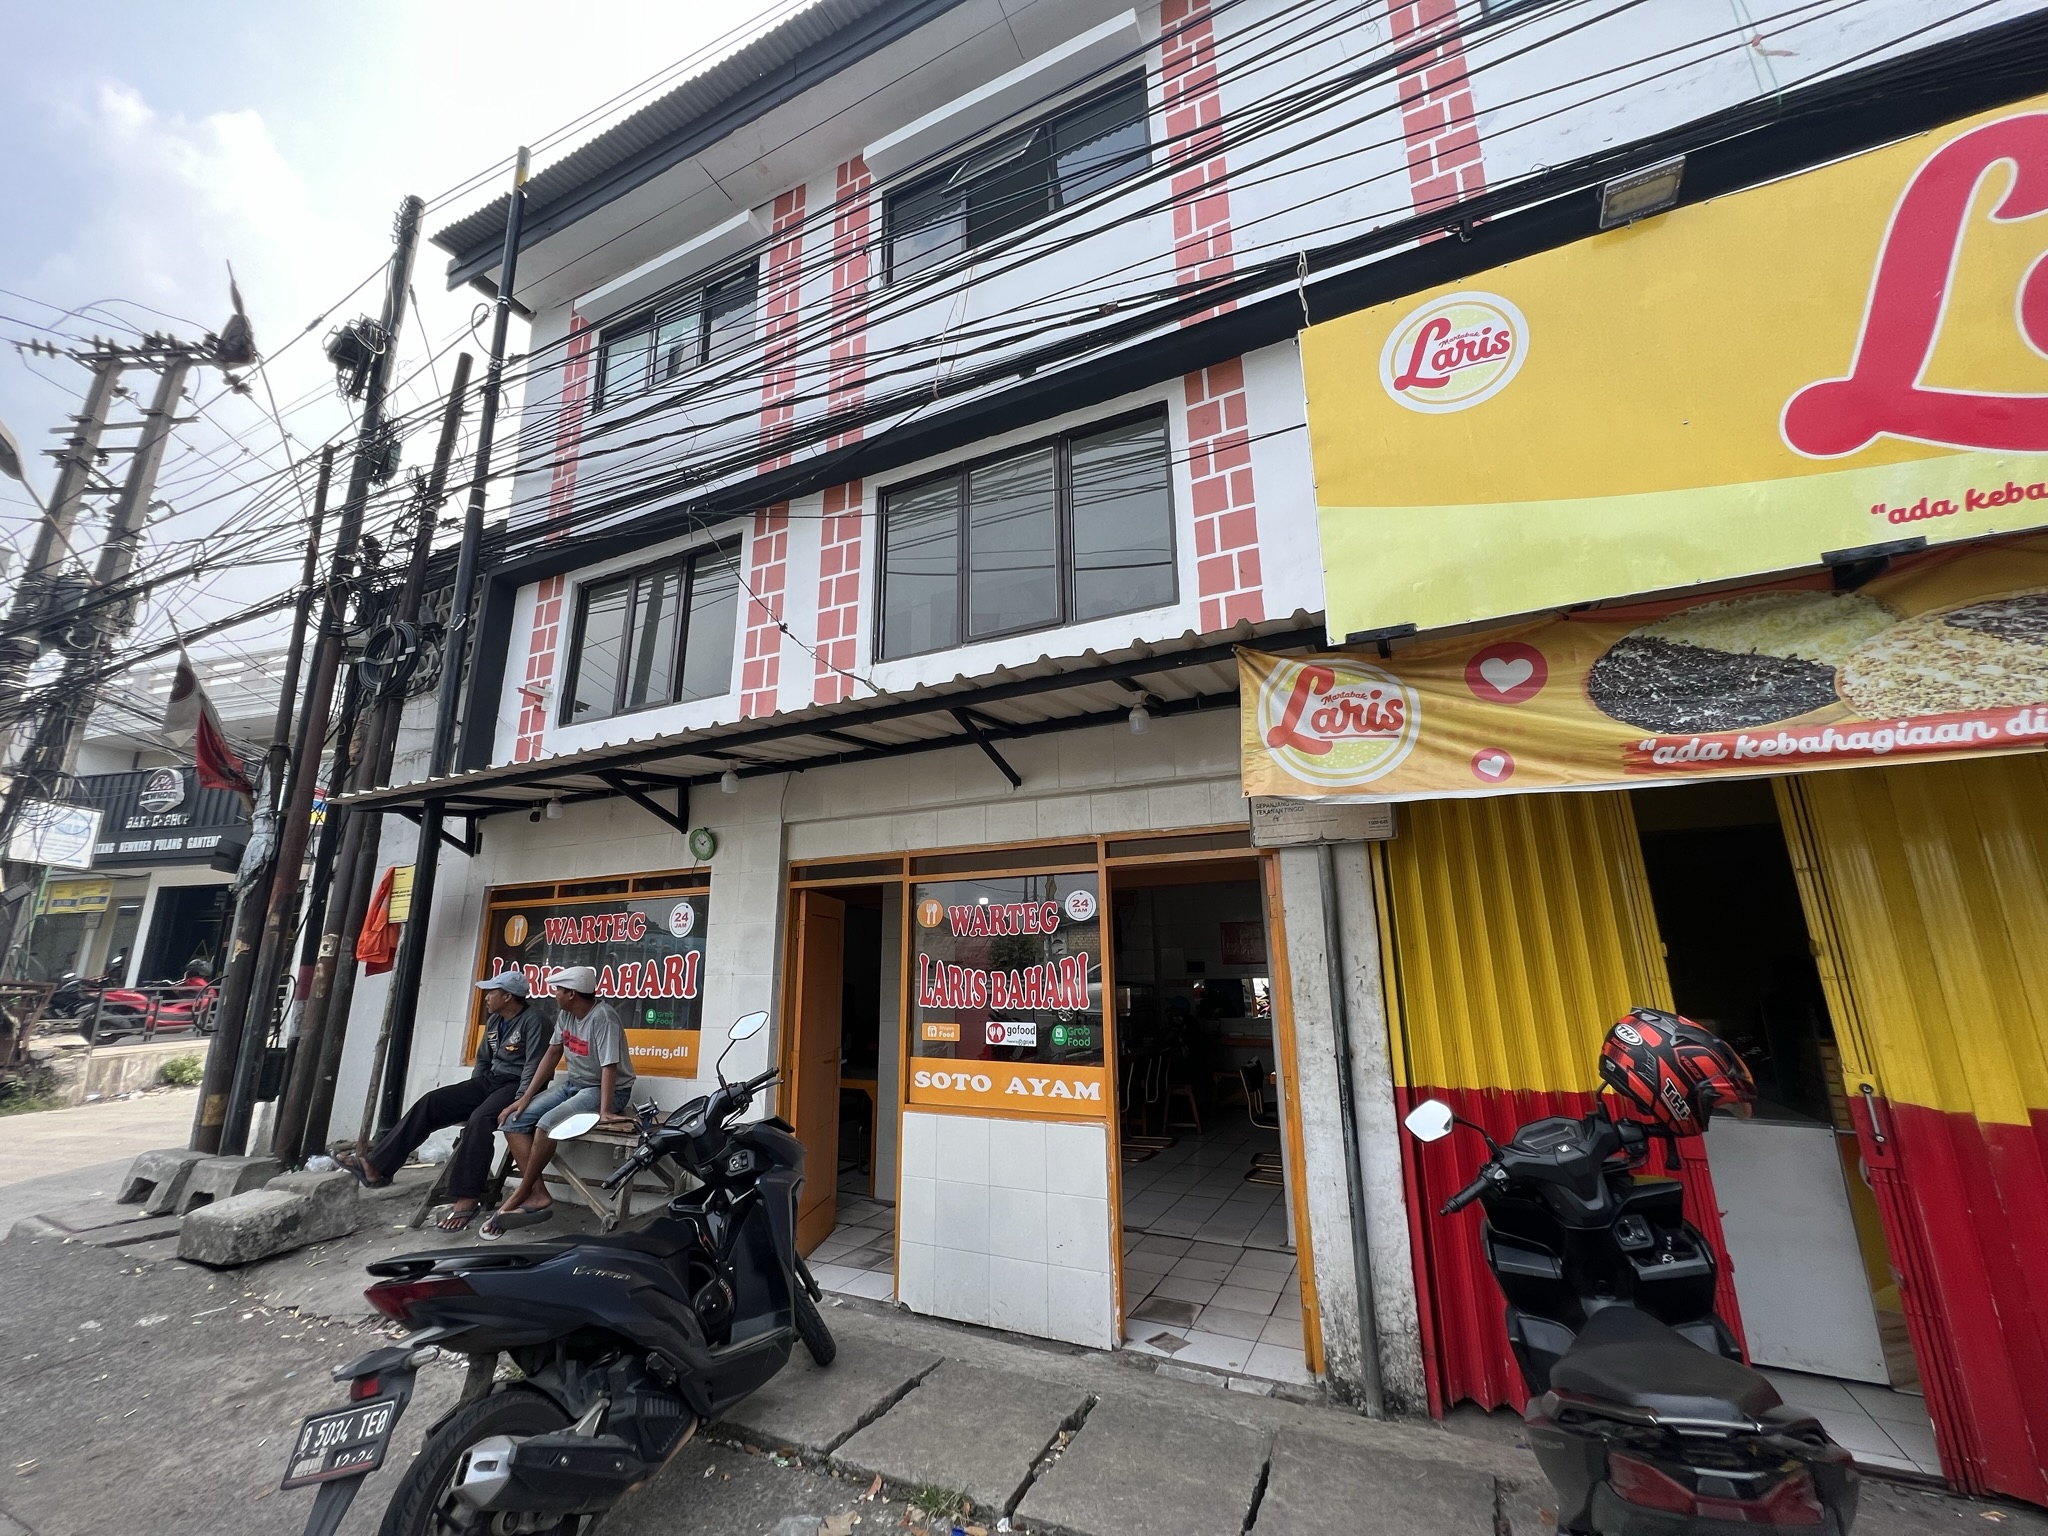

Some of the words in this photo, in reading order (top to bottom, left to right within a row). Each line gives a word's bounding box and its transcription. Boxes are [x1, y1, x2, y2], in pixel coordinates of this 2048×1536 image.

[1779, 109, 2048, 459] L
[1394, 317, 1511, 391] Laris
[1438, 331, 1481, 348] Martabak
[1267, 665, 1405, 755] Laris
[1321, 690, 1369, 704] Martabak
[1732, 719, 1999, 758] kebahagiaan
[674, 912, 689, 922] 24
[949, 901, 1060, 937] WARTEG
[1072, 898, 1089, 909] 24
[544, 912, 647, 946] WARTEG
[595, 950, 700, 999] AHARI
[918, 952, 988, 1009] LARIS
[990, 951, 1089, 1010] BAHARI
[1007, 1026, 1035, 1036] gofood
[1067, 1025, 1090, 1036] Grab
[1067, 1037, 1091, 1047] Food
[628, 1046, 689, 1060] atering,dll
[914, 1070, 992, 1093] SOTO
[1004, 1076, 1101, 1101] AYAM
[301, 1427, 313, 1452] B
[314, 1417, 353, 1448] 5034
